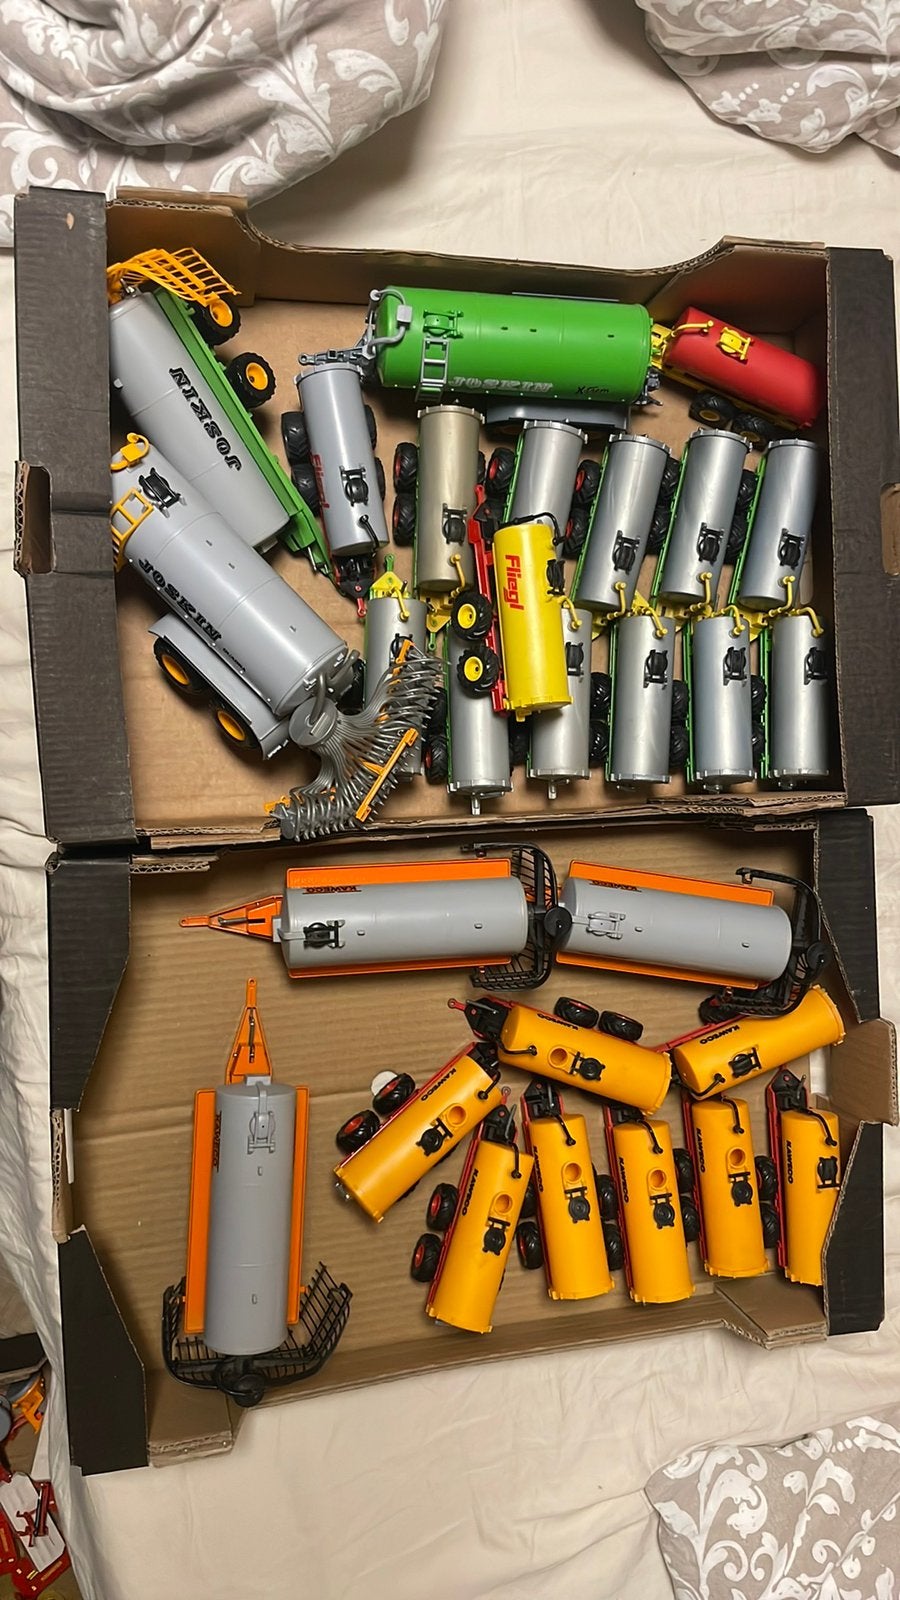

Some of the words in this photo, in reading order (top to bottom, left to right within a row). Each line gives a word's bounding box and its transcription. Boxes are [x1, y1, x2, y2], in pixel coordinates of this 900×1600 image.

[448, 376, 553, 392] JOSKIN
[168, 367, 243, 471] JOSKIN
[138, 558, 222, 641] JOSKIN
[503, 555, 525, 610] Fliegl
[303, 885, 361, 894] KAWECO
[700, 1025, 740, 1044] KAWECO
[421, 1068, 456, 1101] KAWECO
[533, 1145, 544, 1192] KAWECO
[696, 1128, 706, 1173] KAWECO
[785, 1140, 794, 1184] KAWECO
[462, 1168, 478, 1216] KAWECO
[619, 1156, 629, 1203] KAWECO
